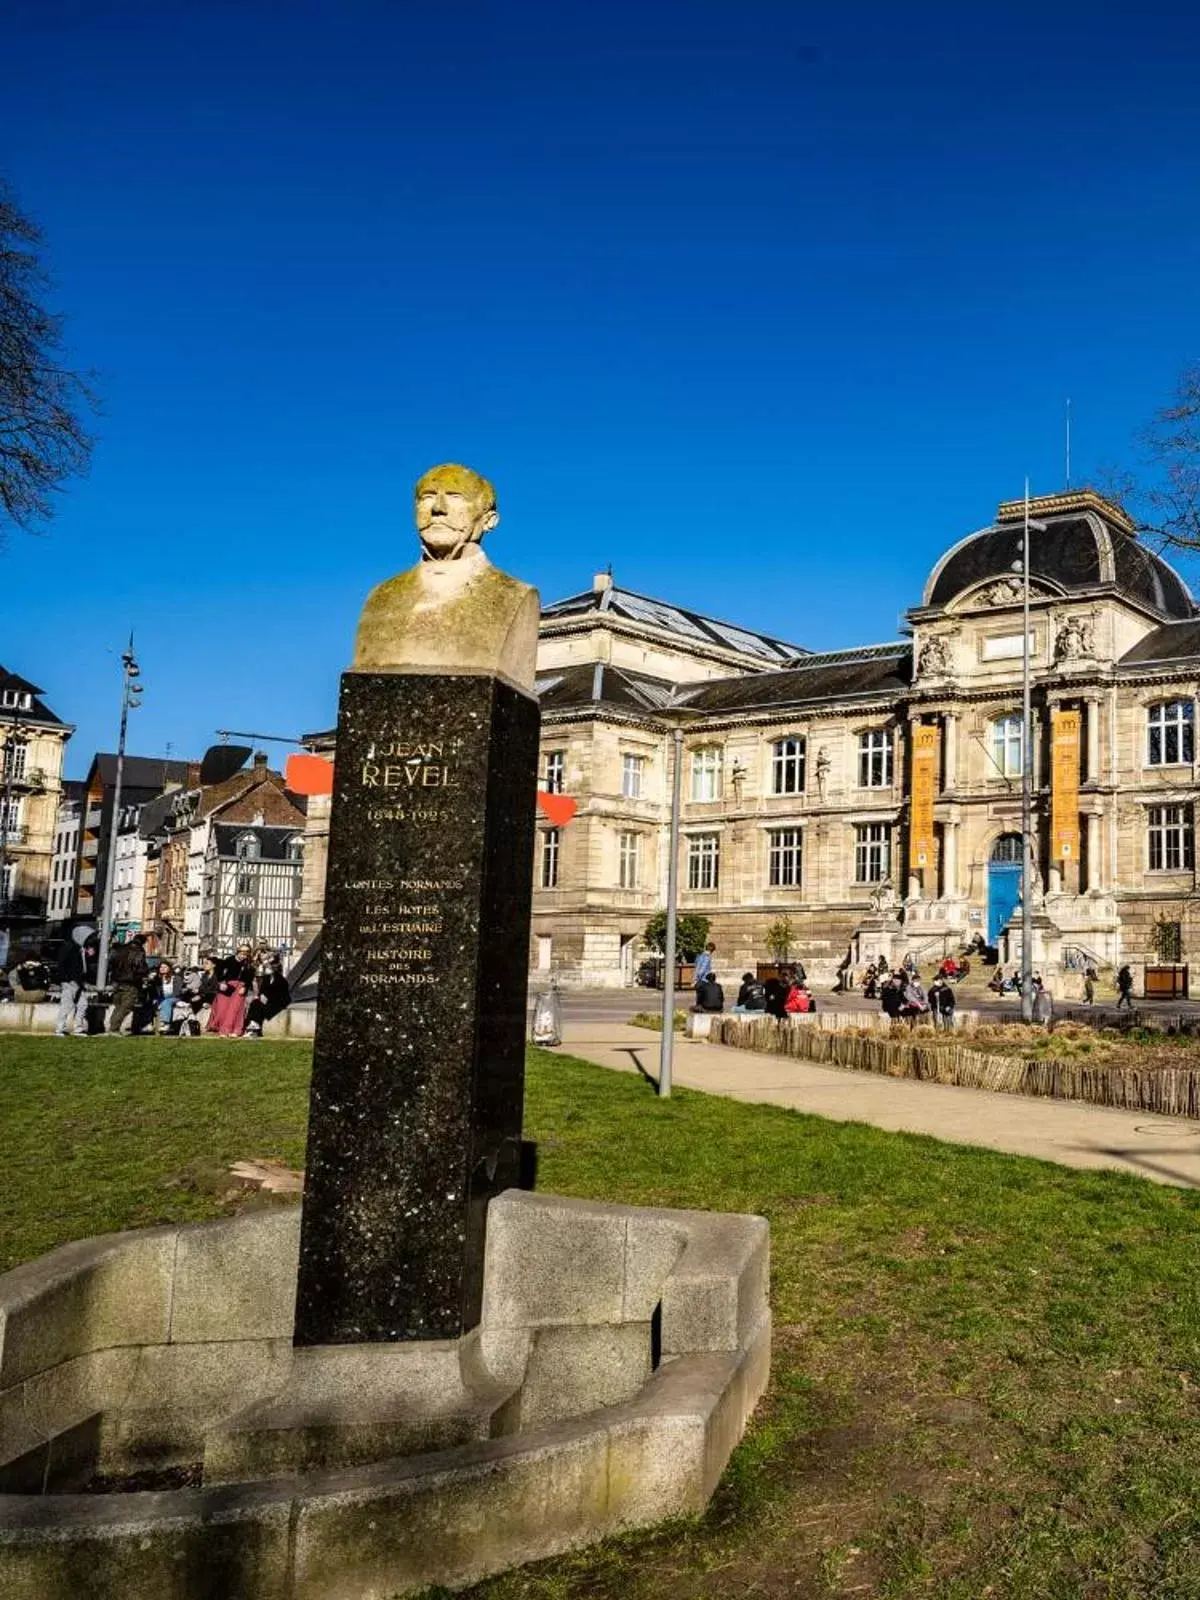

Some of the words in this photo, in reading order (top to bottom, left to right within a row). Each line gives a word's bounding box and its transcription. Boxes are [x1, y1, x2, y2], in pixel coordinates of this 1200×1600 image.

[380, 741, 444, 757] JEAN
[361, 764, 459, 787] REVEL
[367, 810, 448, 822] 1848-1925
[344, 879, 394, 889] CONTES
[400, 879, 463, 890] NORMANDS
[365, 904, 390, 915] LES
[367, 949, 433, 960] HISTOIRE
